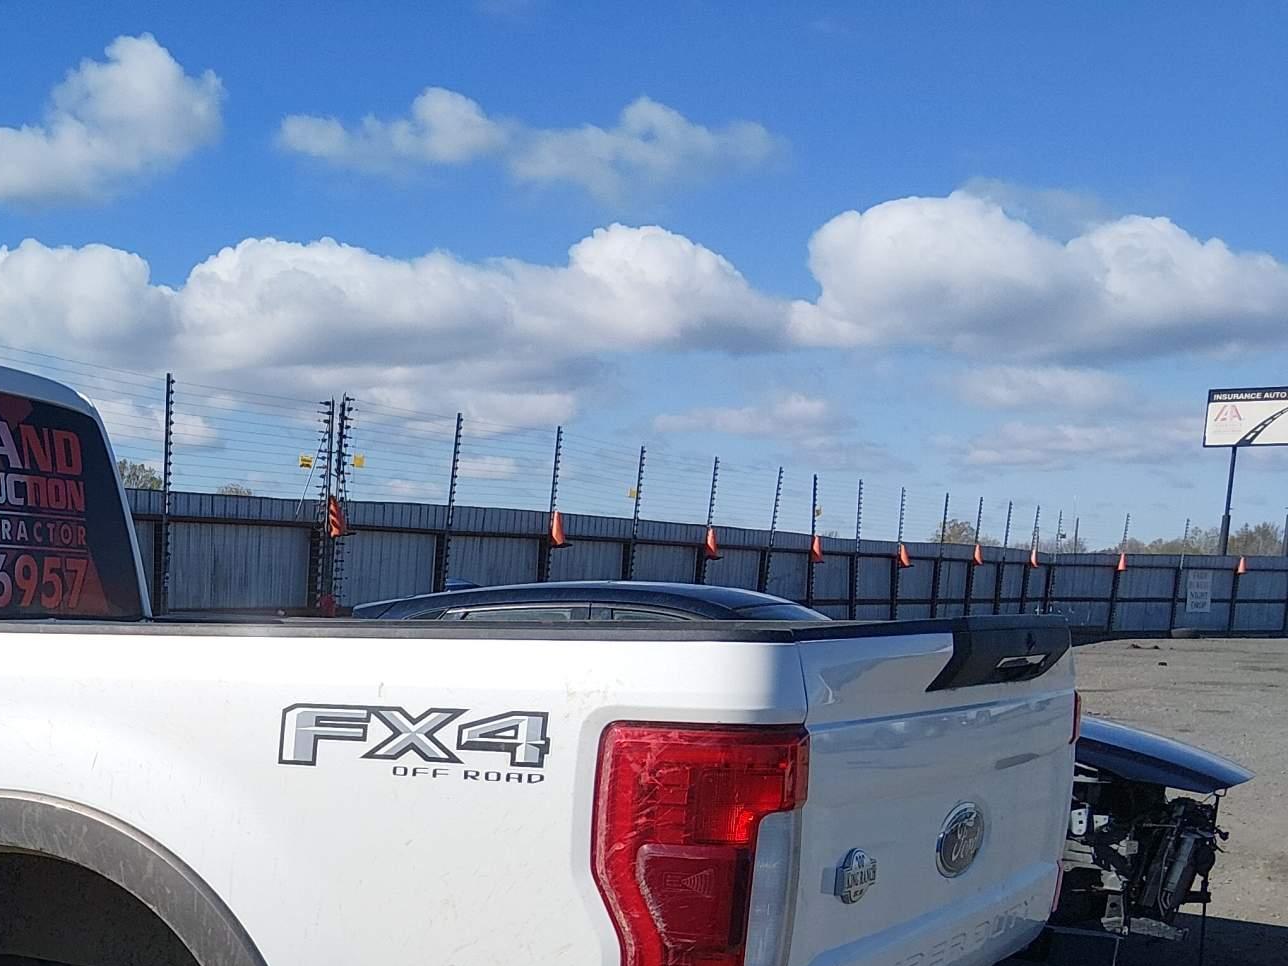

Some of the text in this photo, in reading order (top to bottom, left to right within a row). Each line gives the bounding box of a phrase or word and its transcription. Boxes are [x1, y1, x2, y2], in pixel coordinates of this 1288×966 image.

[1213, 391, 1287, 401] INSURANCE AUTO
[278, 703, 550, 768] FX4
[392, 766, 545, 785] OFF ROAD
